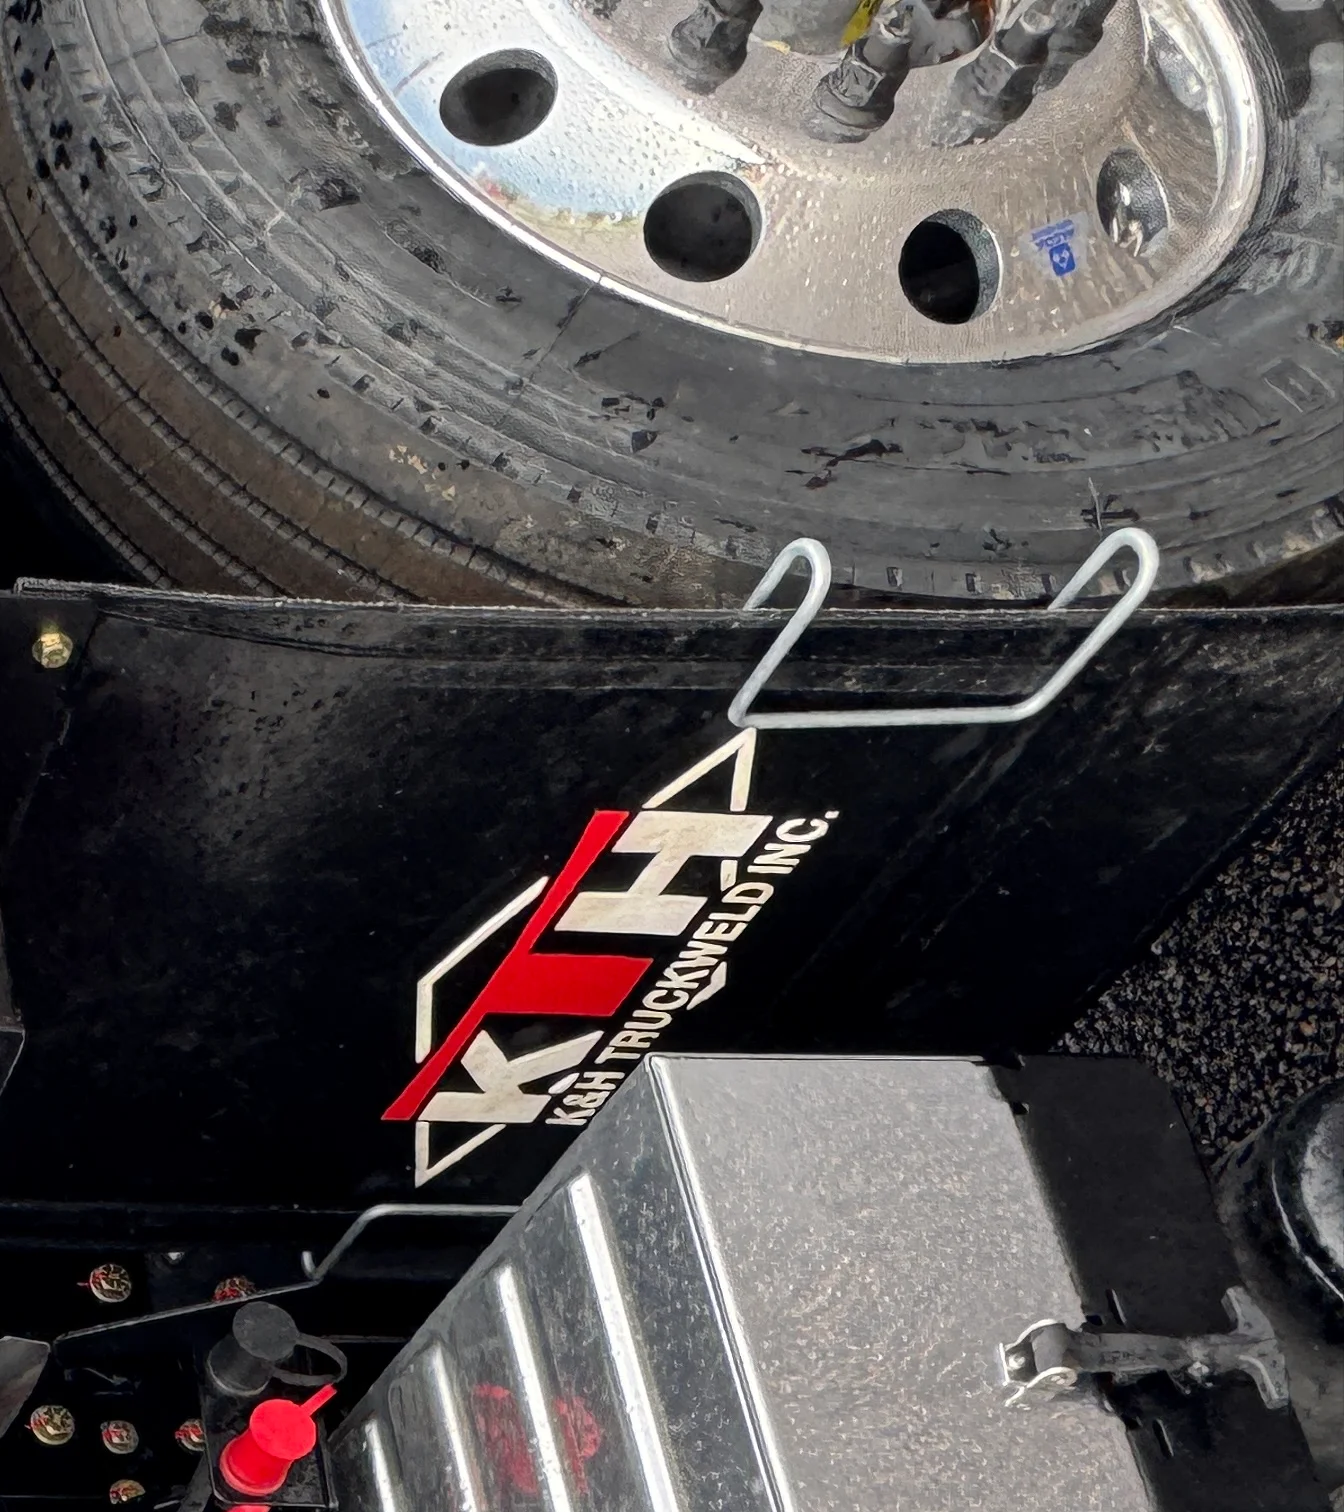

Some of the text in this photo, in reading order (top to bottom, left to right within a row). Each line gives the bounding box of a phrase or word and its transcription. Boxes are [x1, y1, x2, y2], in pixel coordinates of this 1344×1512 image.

[546, 809, 840, 1125] K&H TRUCKWELD INC.
